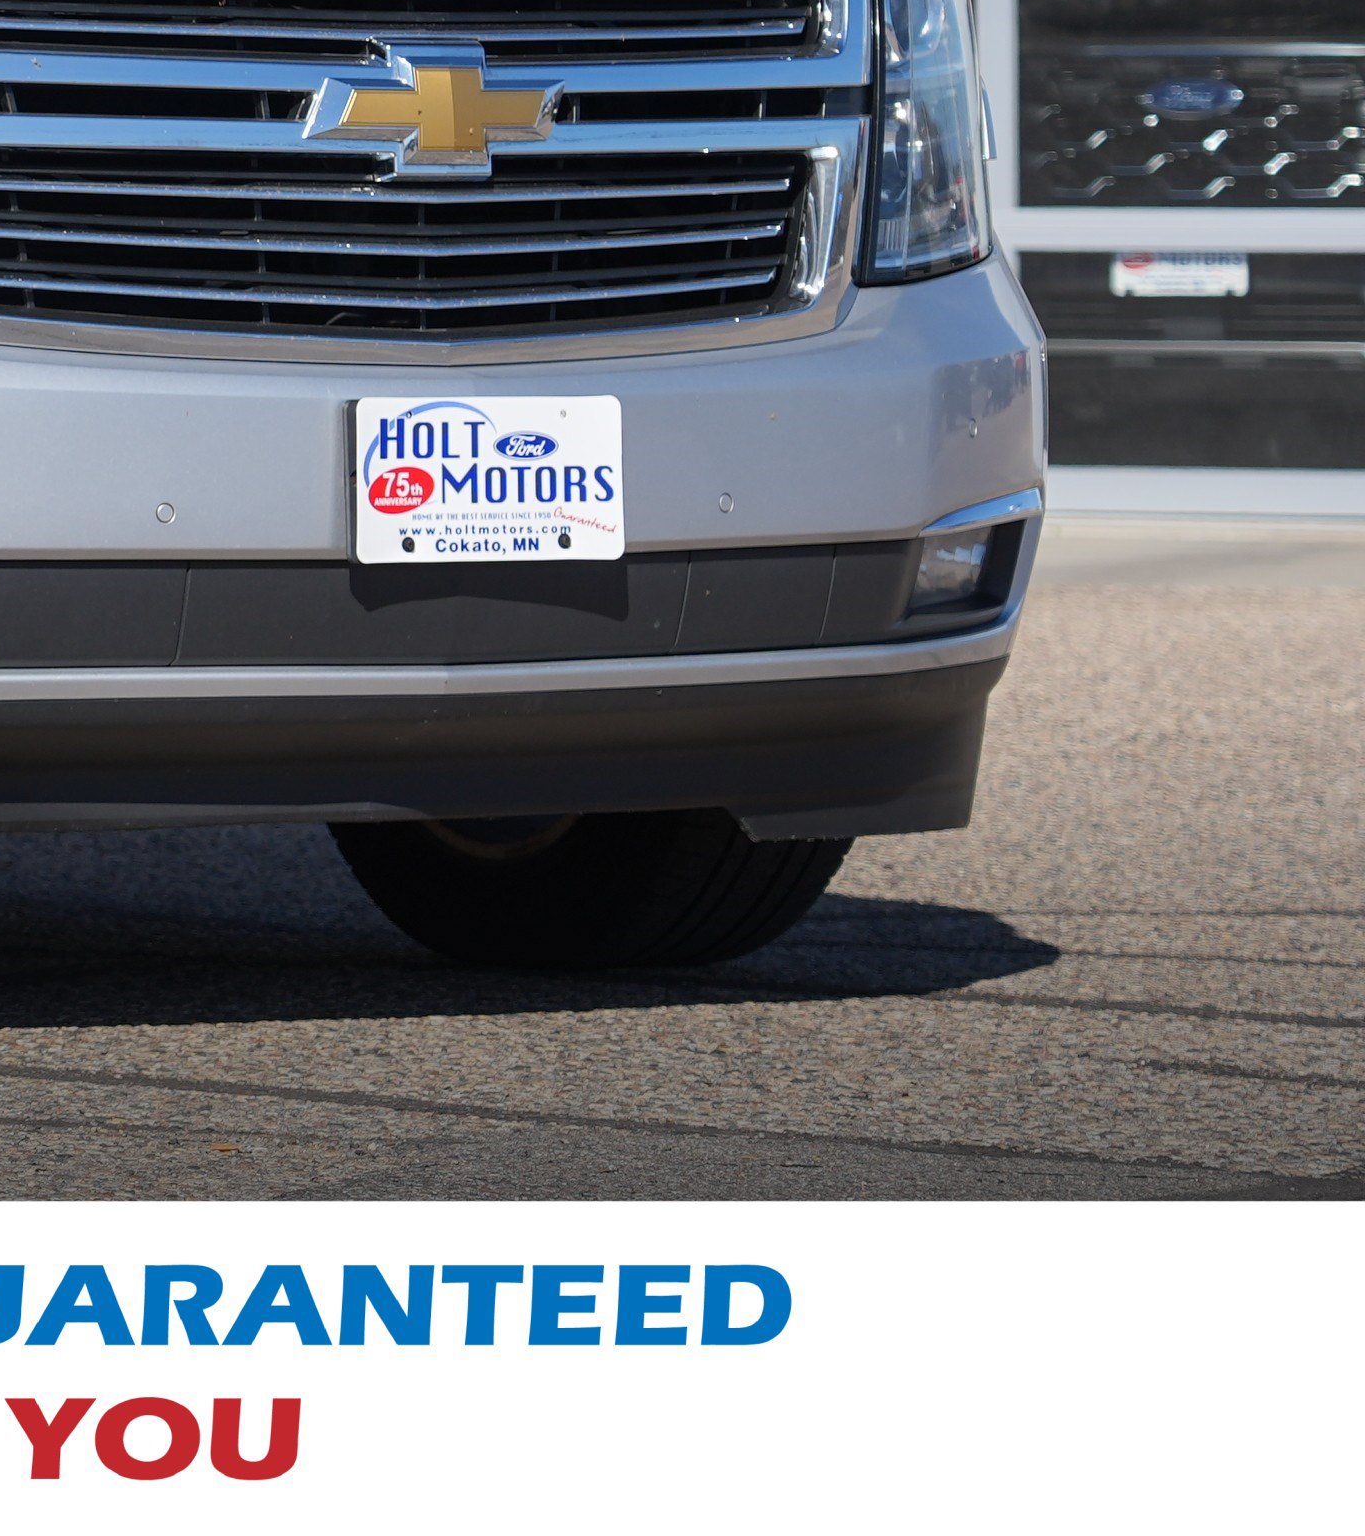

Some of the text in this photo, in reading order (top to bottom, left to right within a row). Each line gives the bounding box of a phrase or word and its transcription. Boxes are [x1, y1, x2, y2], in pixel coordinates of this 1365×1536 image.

[379, 418, 486, 459] HOLT
[505, 434, 546, 458] Ford
[382, 471, 424, 498] 75th
[441, 463, 615, 504] MOTORS
[373, 496, 423, 507] ANNIVERSARY
[412, 513, 434, 521] HOME
[511, 512, 532, 520] SINCE
[553, 506, 617, 534] Guaranteed
[399, 524, 571, 536] www.holtmotors.com
[435, 537, 540, 555] Cokato, MN
